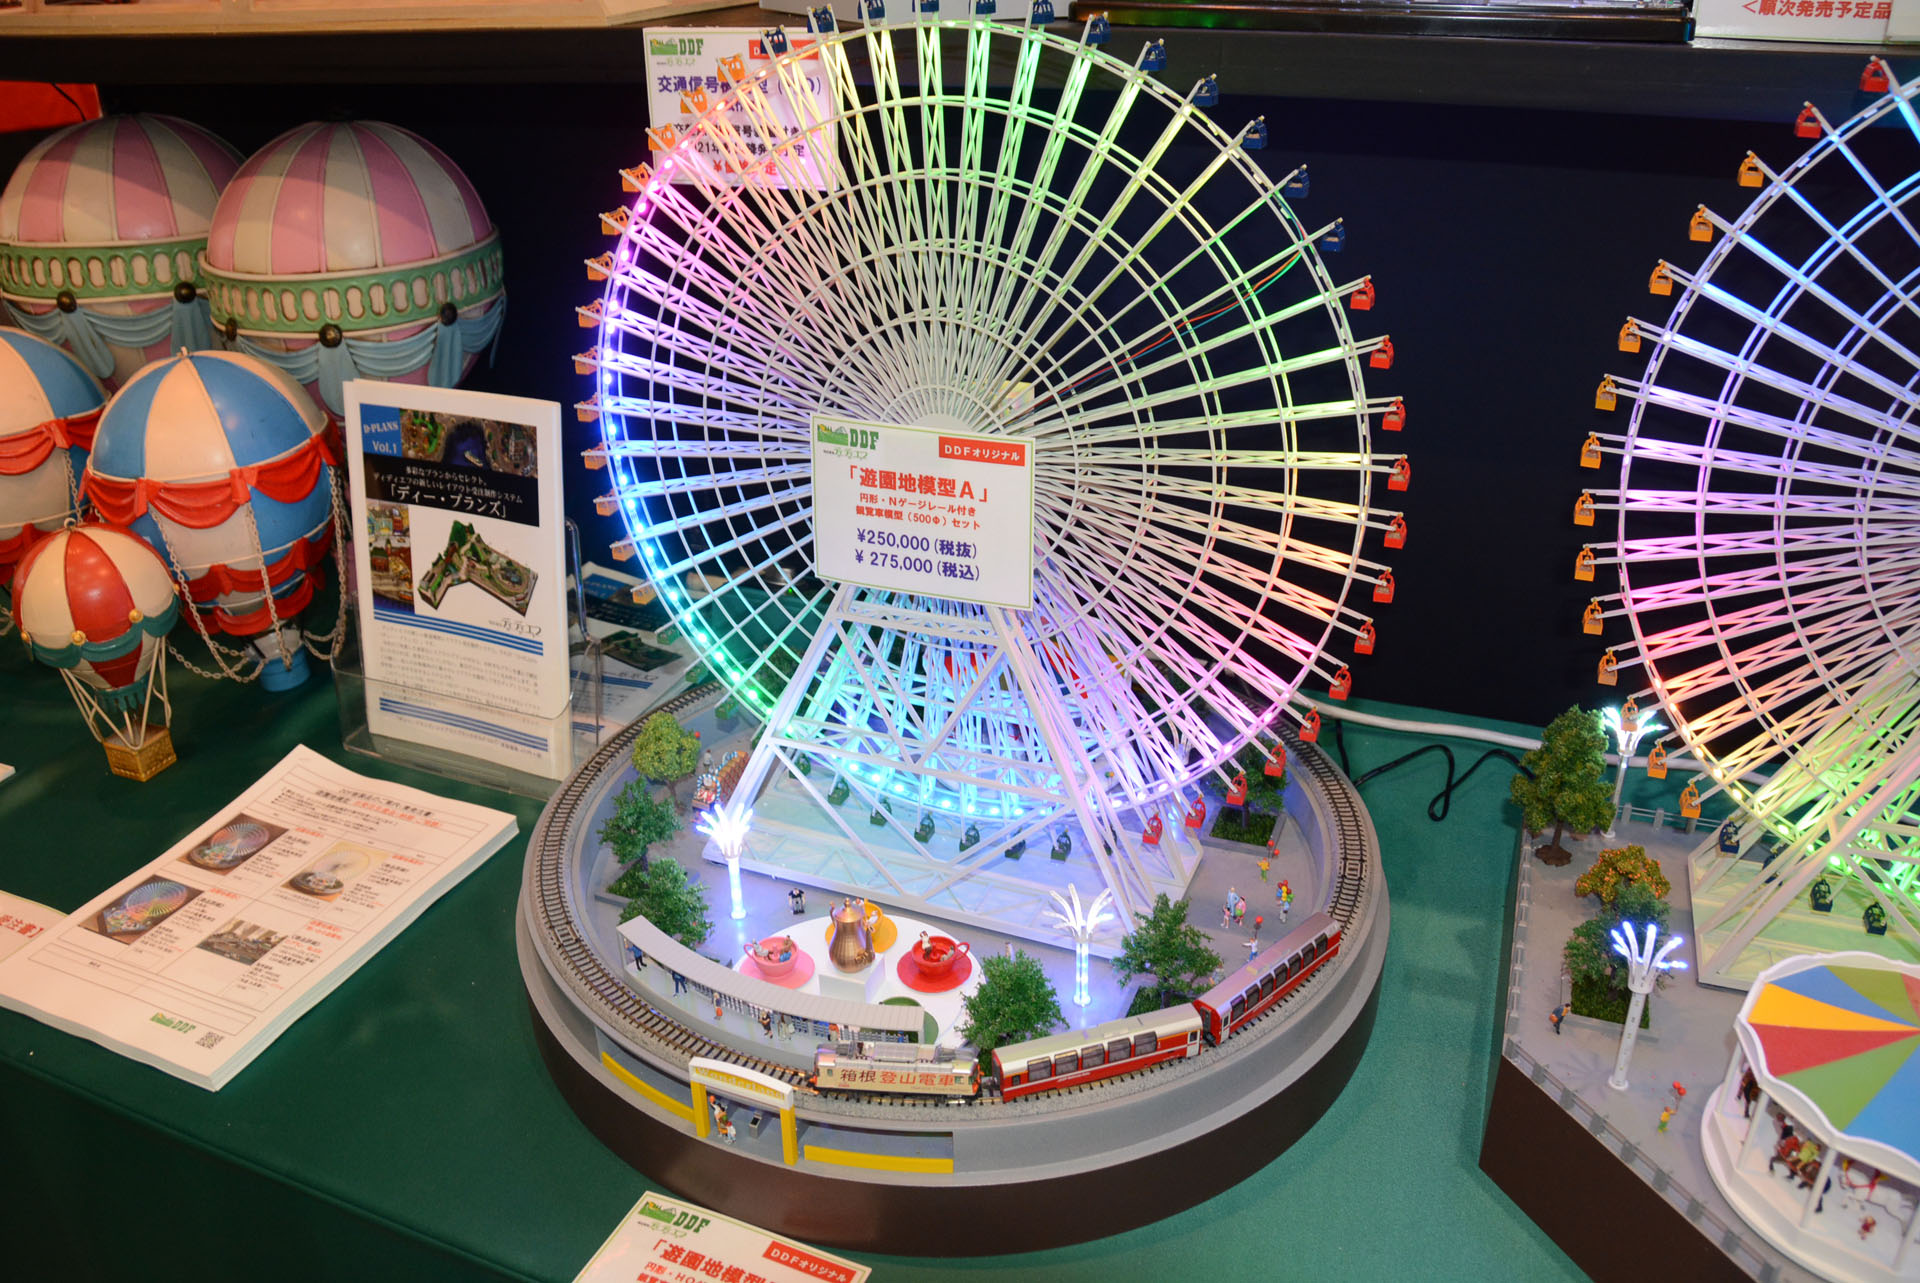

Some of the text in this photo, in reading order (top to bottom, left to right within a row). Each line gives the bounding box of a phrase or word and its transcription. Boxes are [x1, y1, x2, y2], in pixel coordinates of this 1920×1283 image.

[679, 38, 704, 56] DDF
[849, 428, 879, 450] DDF
[944, 444, 1020, 462] DDFオリジナル
[672, 1211, 711, 1233] DDF
[770, 1248, 847, 1282] DDFオリジナル
